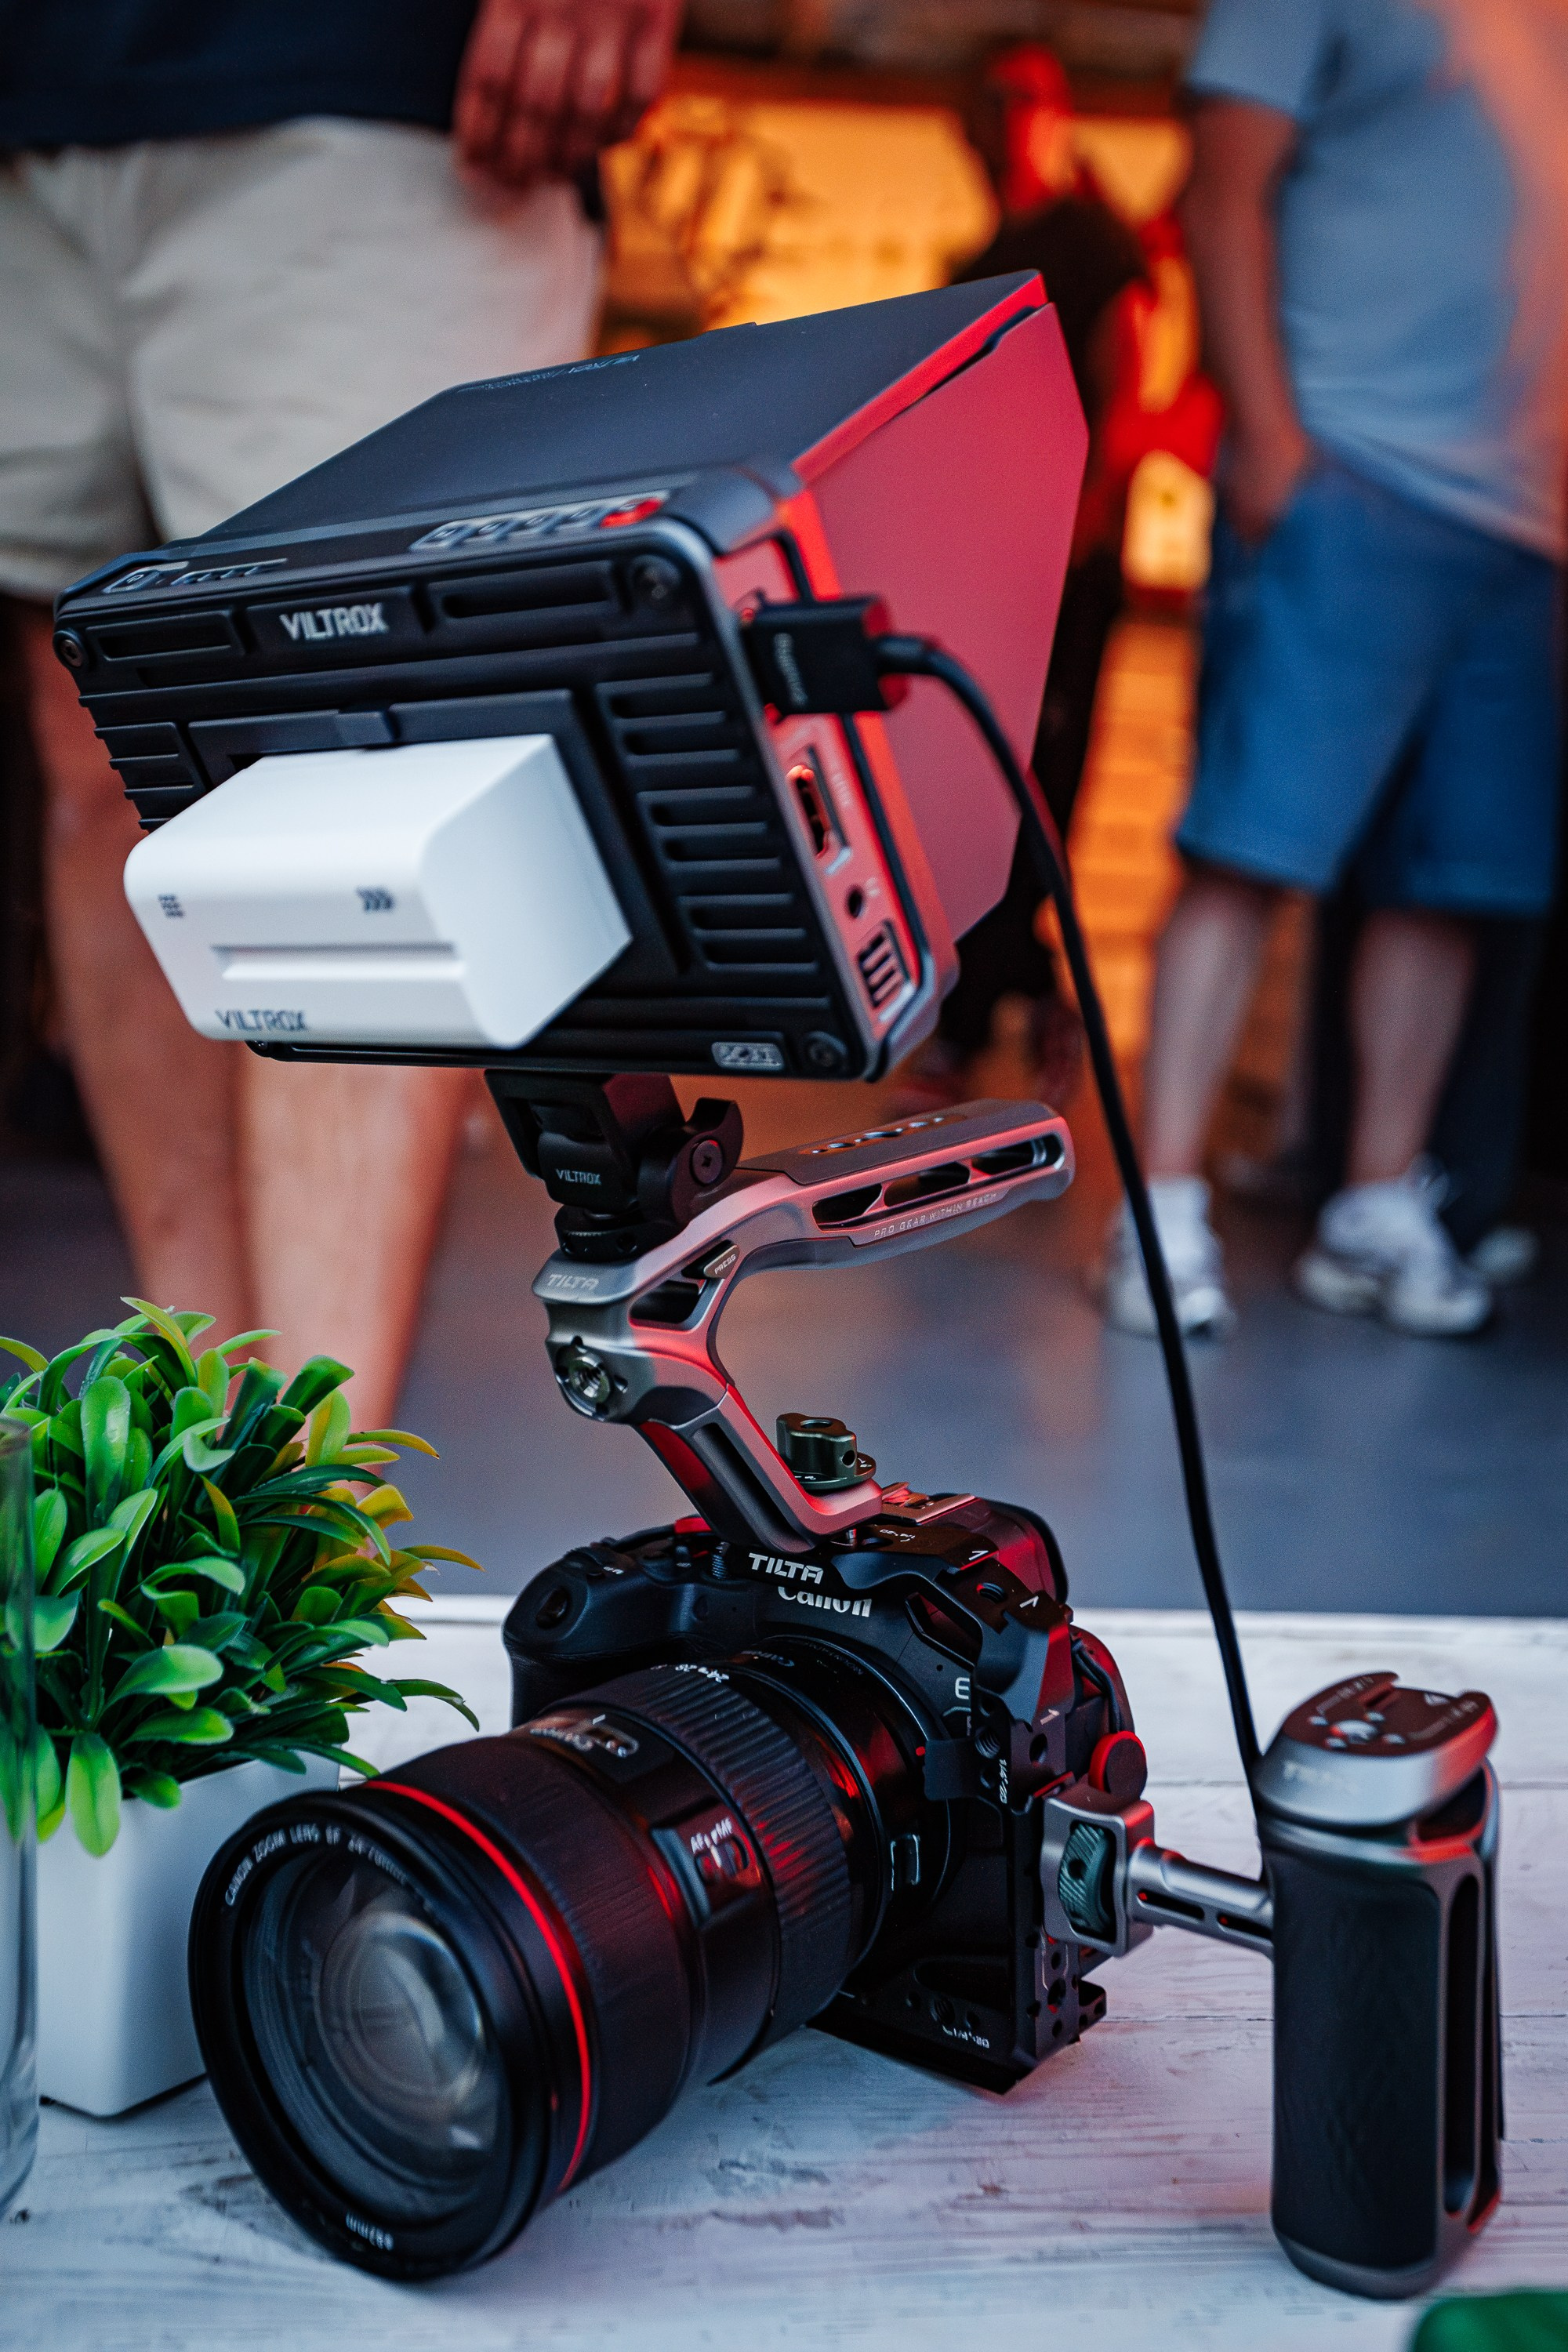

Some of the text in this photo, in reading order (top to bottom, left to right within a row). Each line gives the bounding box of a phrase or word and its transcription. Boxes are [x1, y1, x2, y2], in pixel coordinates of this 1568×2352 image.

[278, 602, 390, 641] VILTROX
[214, 1008, 310, 1032] VILTROX
[555, 1168, 602, 1185] VILTROX
[874, 1225, 895, 1237] PRO
[899, 1214, 926, 1230] GEAR
[714, 1254, 737, 1275] PRESS
[547, 1273, 600, 1290] TILTA
[749, 1552, 824, 1584] TILTA
[252, 1828, 286, 1864] ZOOM
